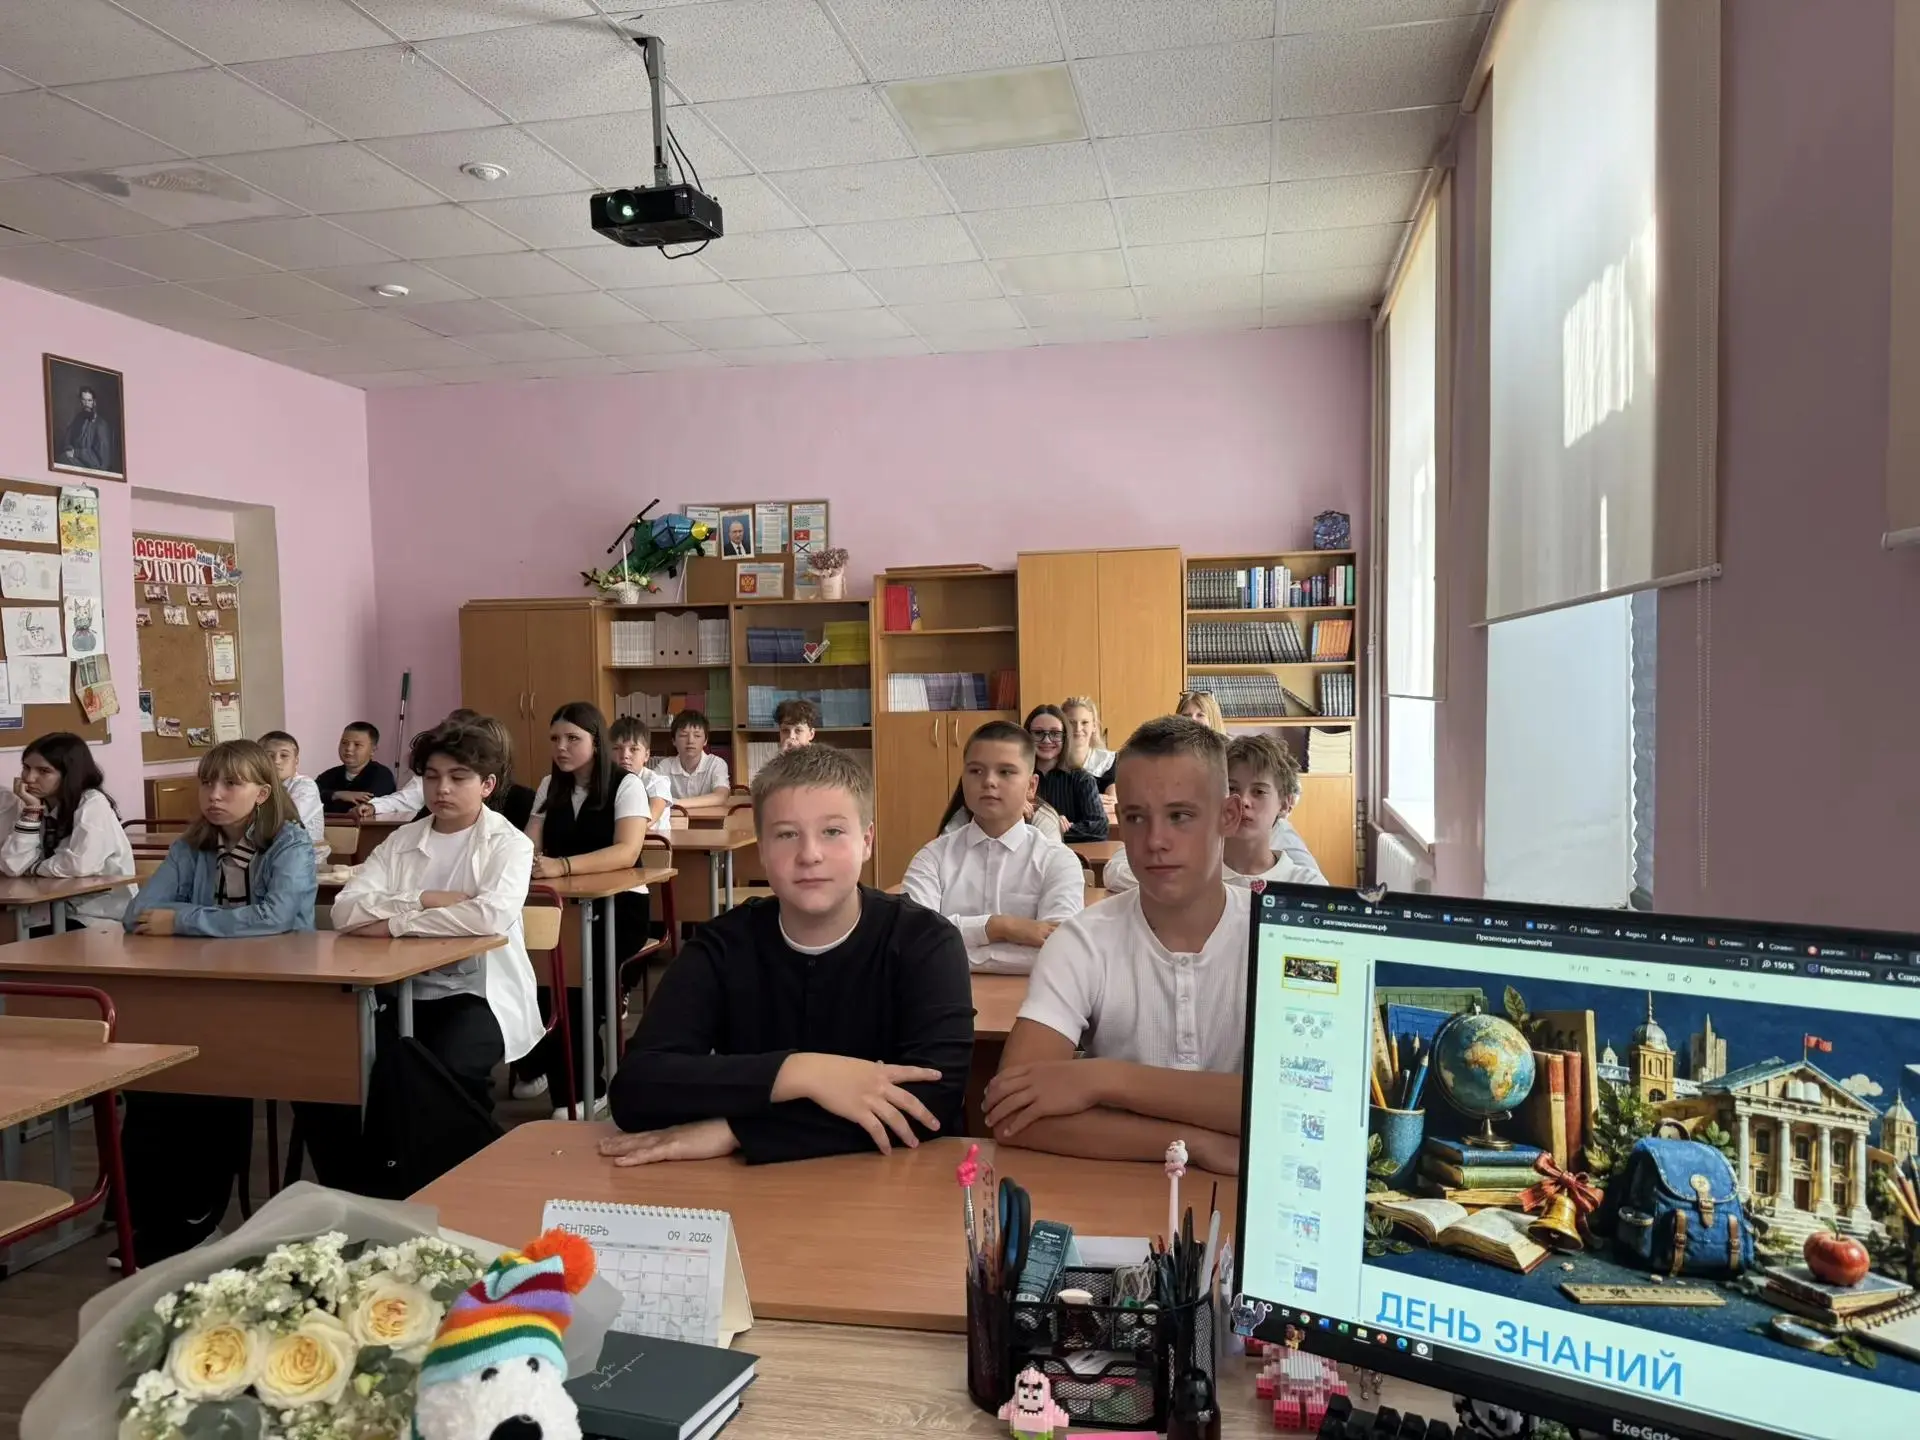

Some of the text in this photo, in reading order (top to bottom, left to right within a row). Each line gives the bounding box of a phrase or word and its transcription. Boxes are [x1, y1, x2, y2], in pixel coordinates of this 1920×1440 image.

[132, 539, 197, 560] АССНЫЙ
[142, 560, 206, 585] УГОЛОК
[1495, 919, 1508, 927] MAX
[1475, 933, 1553, 947] Презентация PowerPoint
[1773, 961, 1795, 971] 150%
[1820, 965, 1870, 978] Пересказать
[667, 1230, 713, 1244] 09 2026
[1375, 1290, 1683, 1396] ДЕНЬ ЗНАНИЙ
[1612, 1418, 1681, 1440] ExeGat
